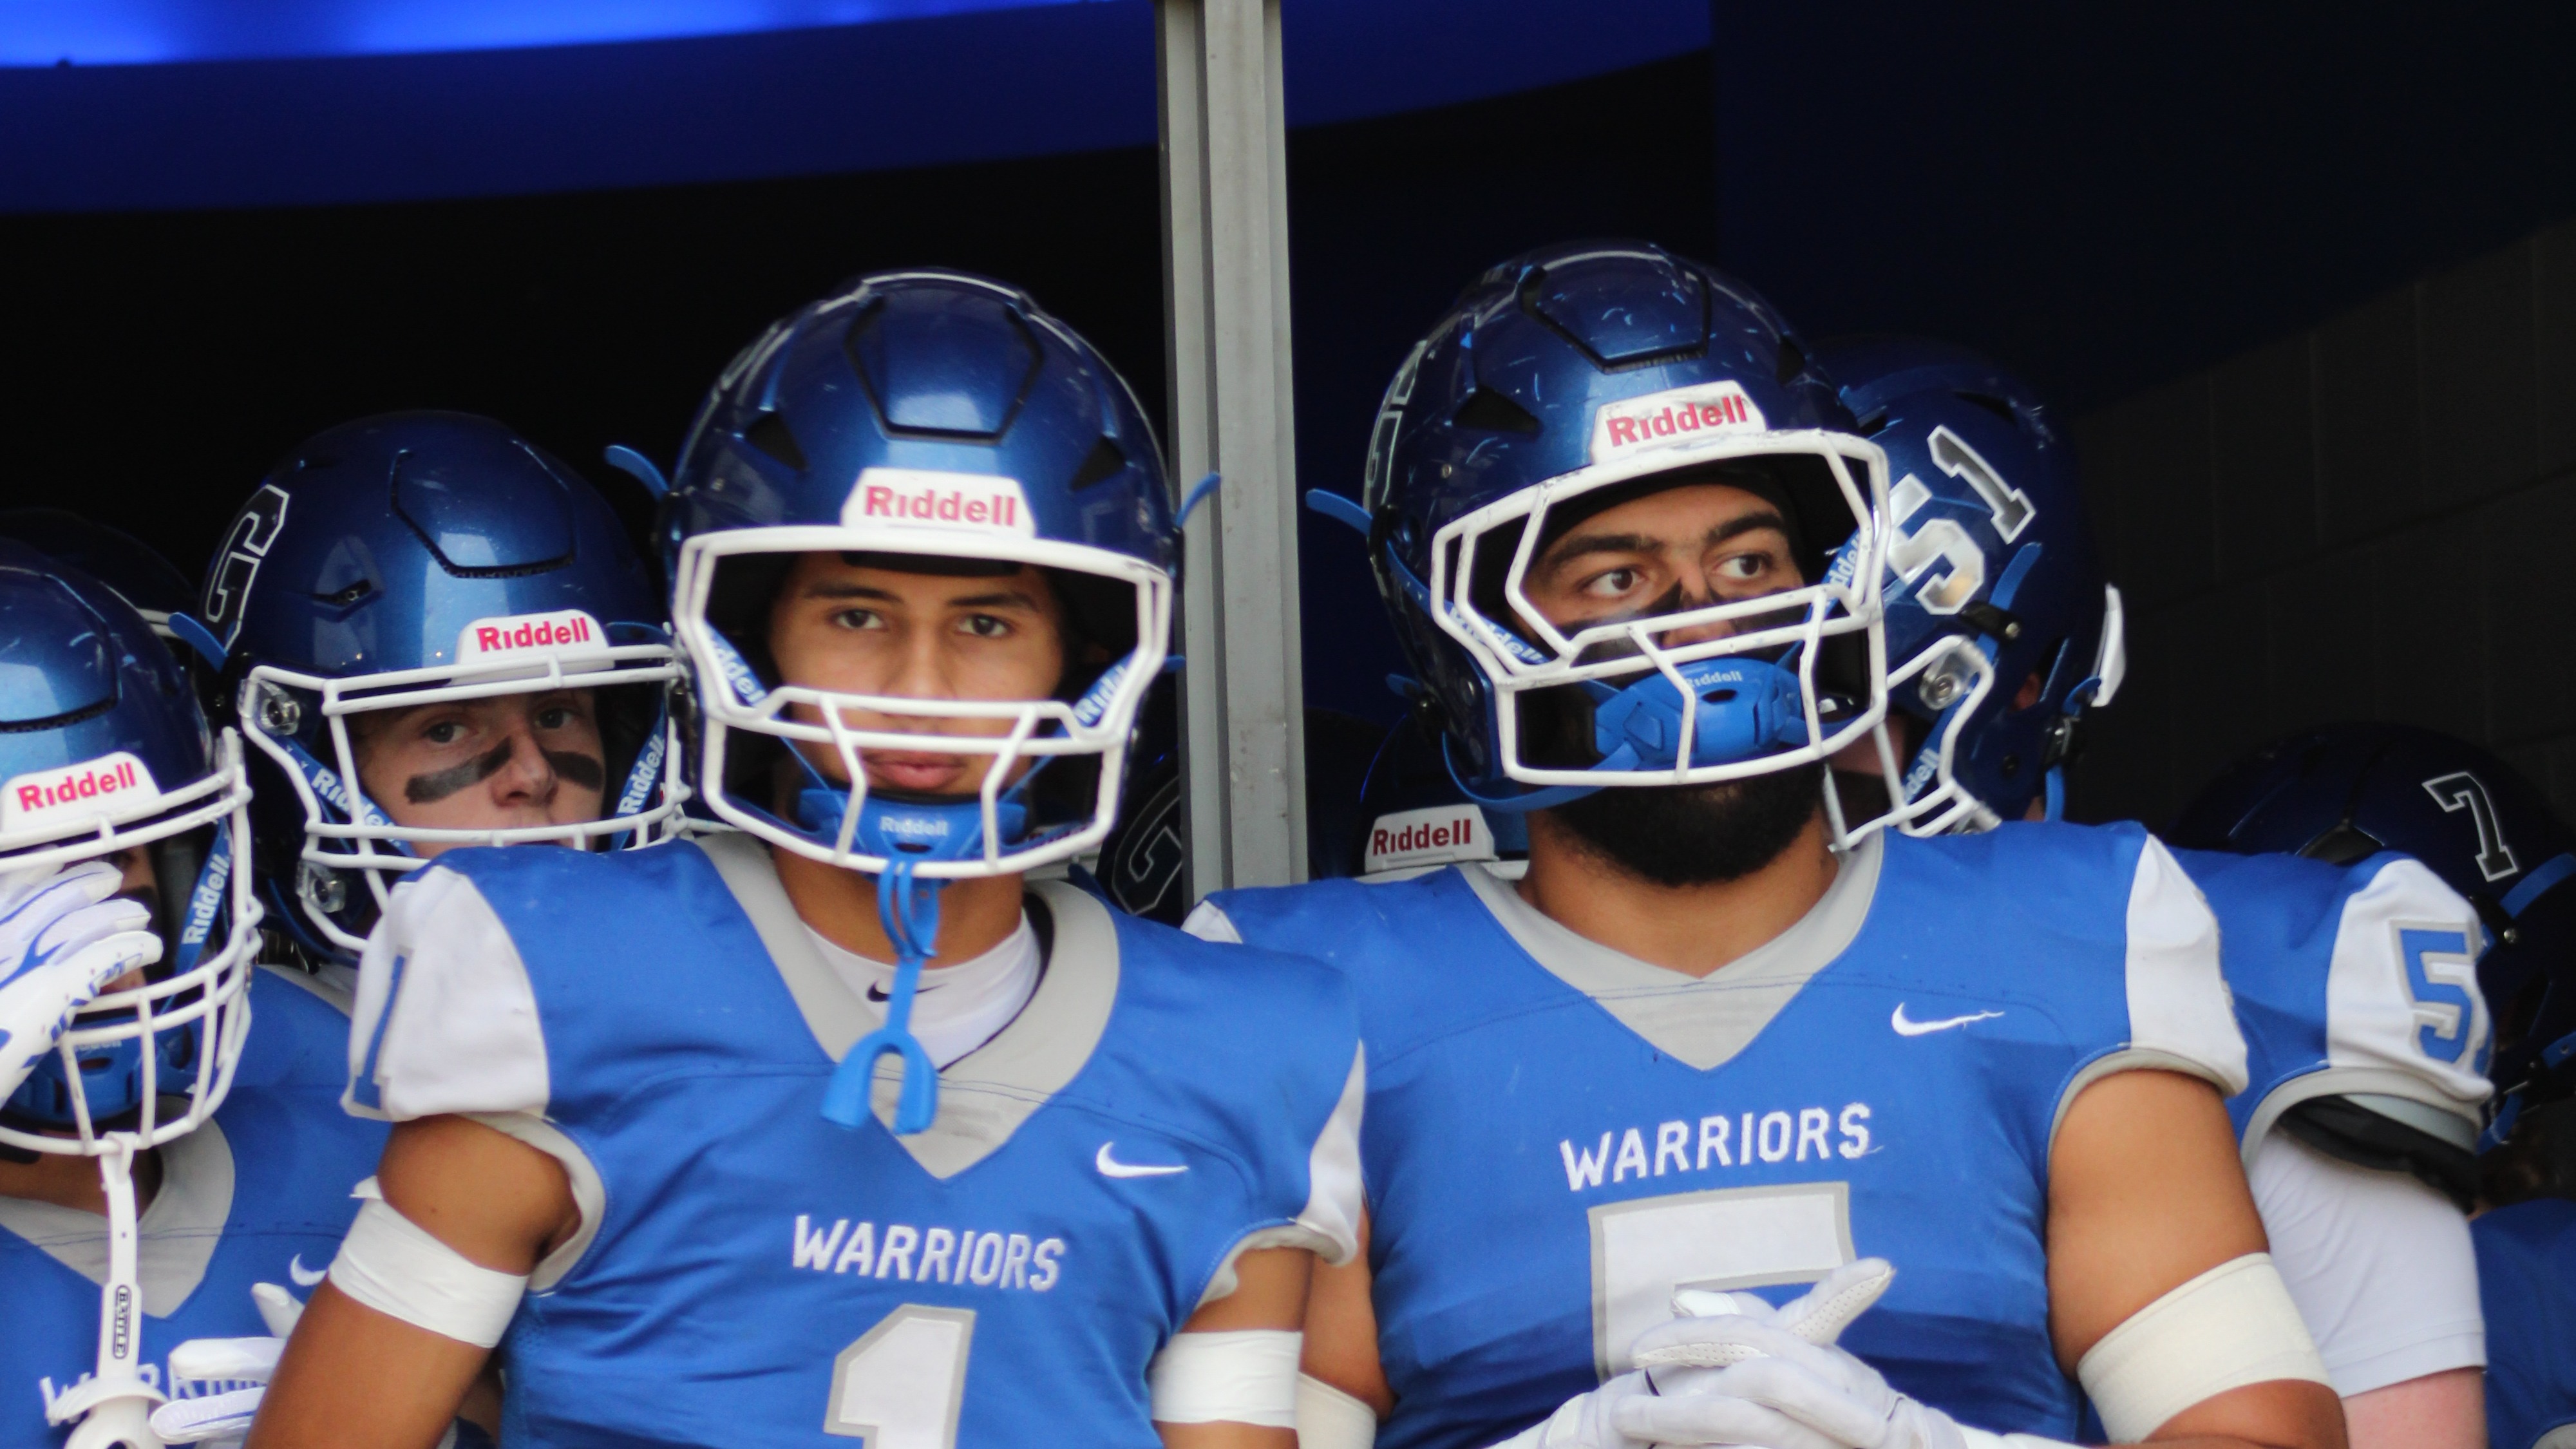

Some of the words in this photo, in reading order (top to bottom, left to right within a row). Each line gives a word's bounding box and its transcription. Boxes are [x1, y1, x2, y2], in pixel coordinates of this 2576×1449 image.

[1606, 394, 1747, 447] Riddell
[865, 484, 1016, 527] Riddell
[1873, 424, 2037, 615] 51
[476, 616, 589, 652] Riddell
[17, 761, 135, 811] Riddell
[606, 734, 665, 814] Riddell
[880, 815, 948, 837] Riddell
[1373, 819, 1471, 856] Riddell
[2421, 772, 2519, 882] 7
[180, 847, 230, 945] Riddell
[1559, 1102, 1870, 1192] WARRIORS
[793, 1214, 1066, 1291] WARRIORS
